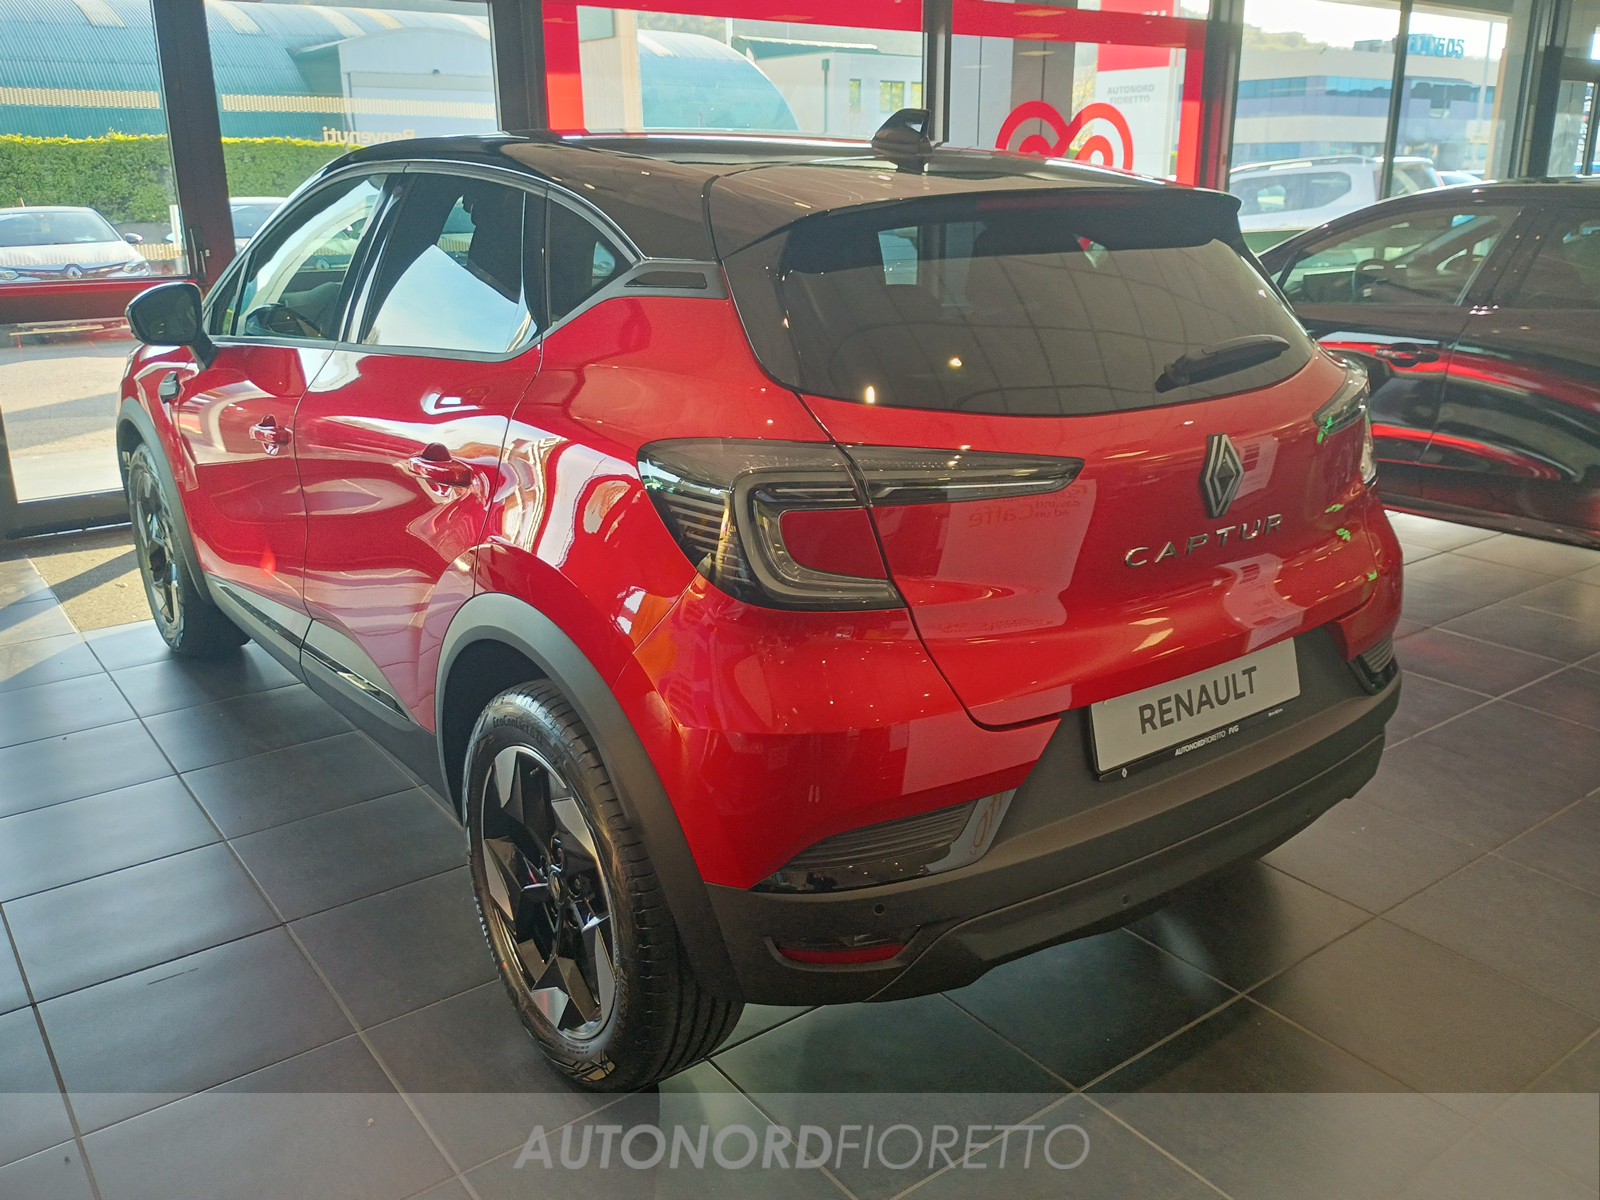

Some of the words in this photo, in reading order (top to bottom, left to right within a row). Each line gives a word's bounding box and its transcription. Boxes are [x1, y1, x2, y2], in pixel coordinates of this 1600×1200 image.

[1107, 84, 1155, 95] AUTONORD
[1124, 513, 1284, 569] CAPTUR
[1138, 666, 1257, 734] RENAULT
